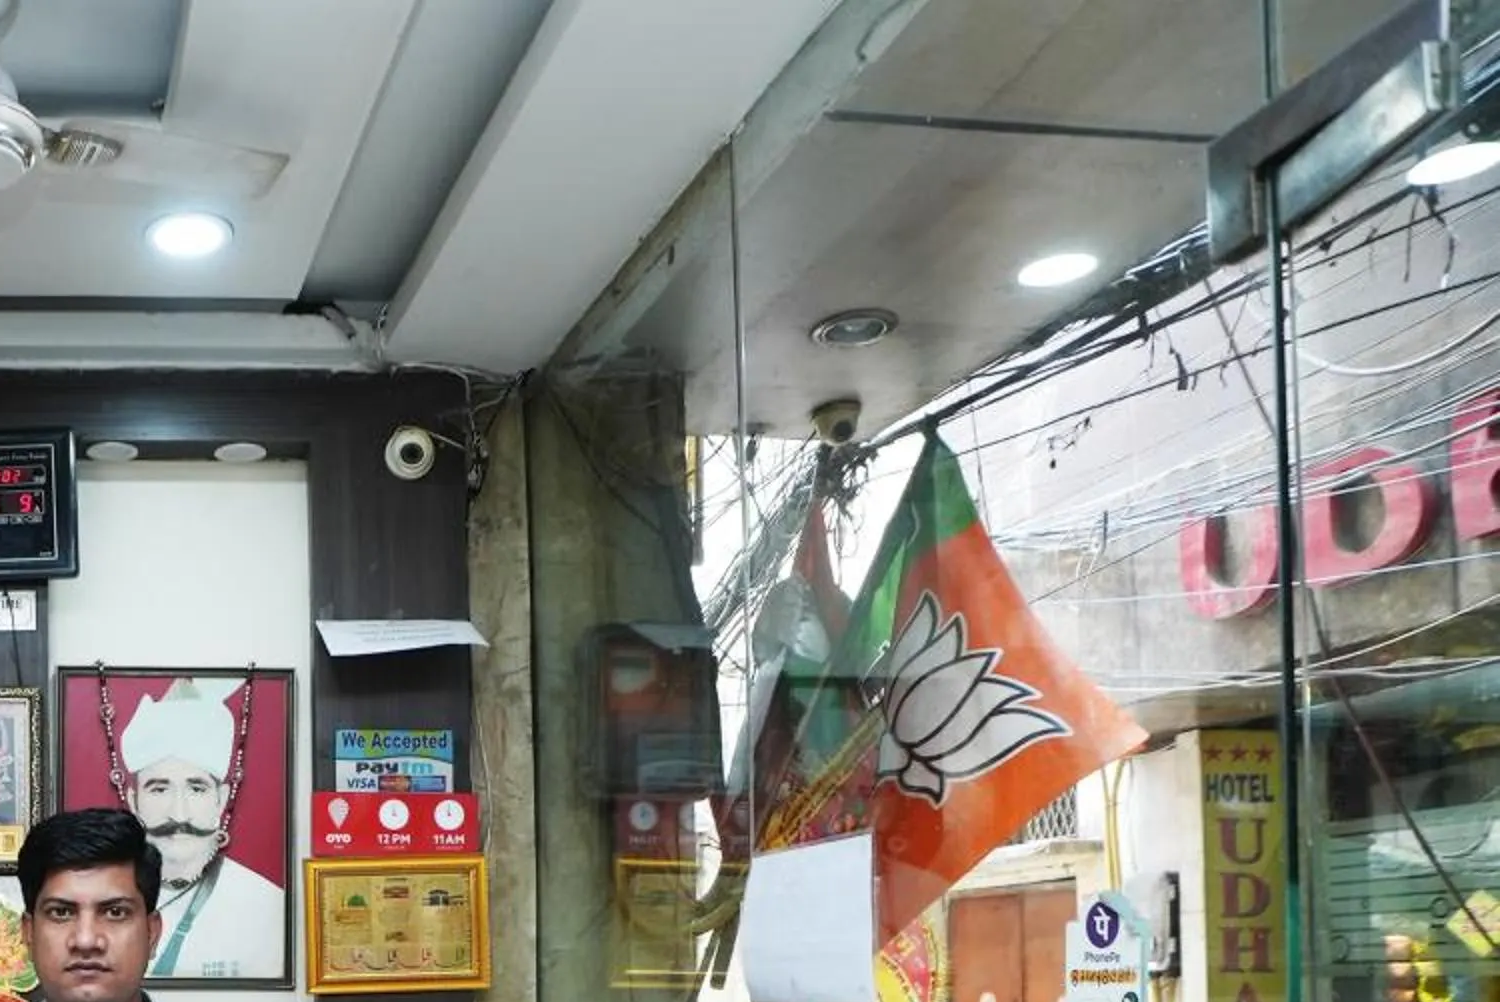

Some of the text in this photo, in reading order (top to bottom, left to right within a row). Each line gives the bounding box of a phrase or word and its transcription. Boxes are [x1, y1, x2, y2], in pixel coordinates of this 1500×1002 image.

[342, 731, 448, 752] We Accepted
[347, 778, 377, 789] VISA
[1205, 773, 1275, 803] HOTEL
[325, 833, 352, 844] OYO
